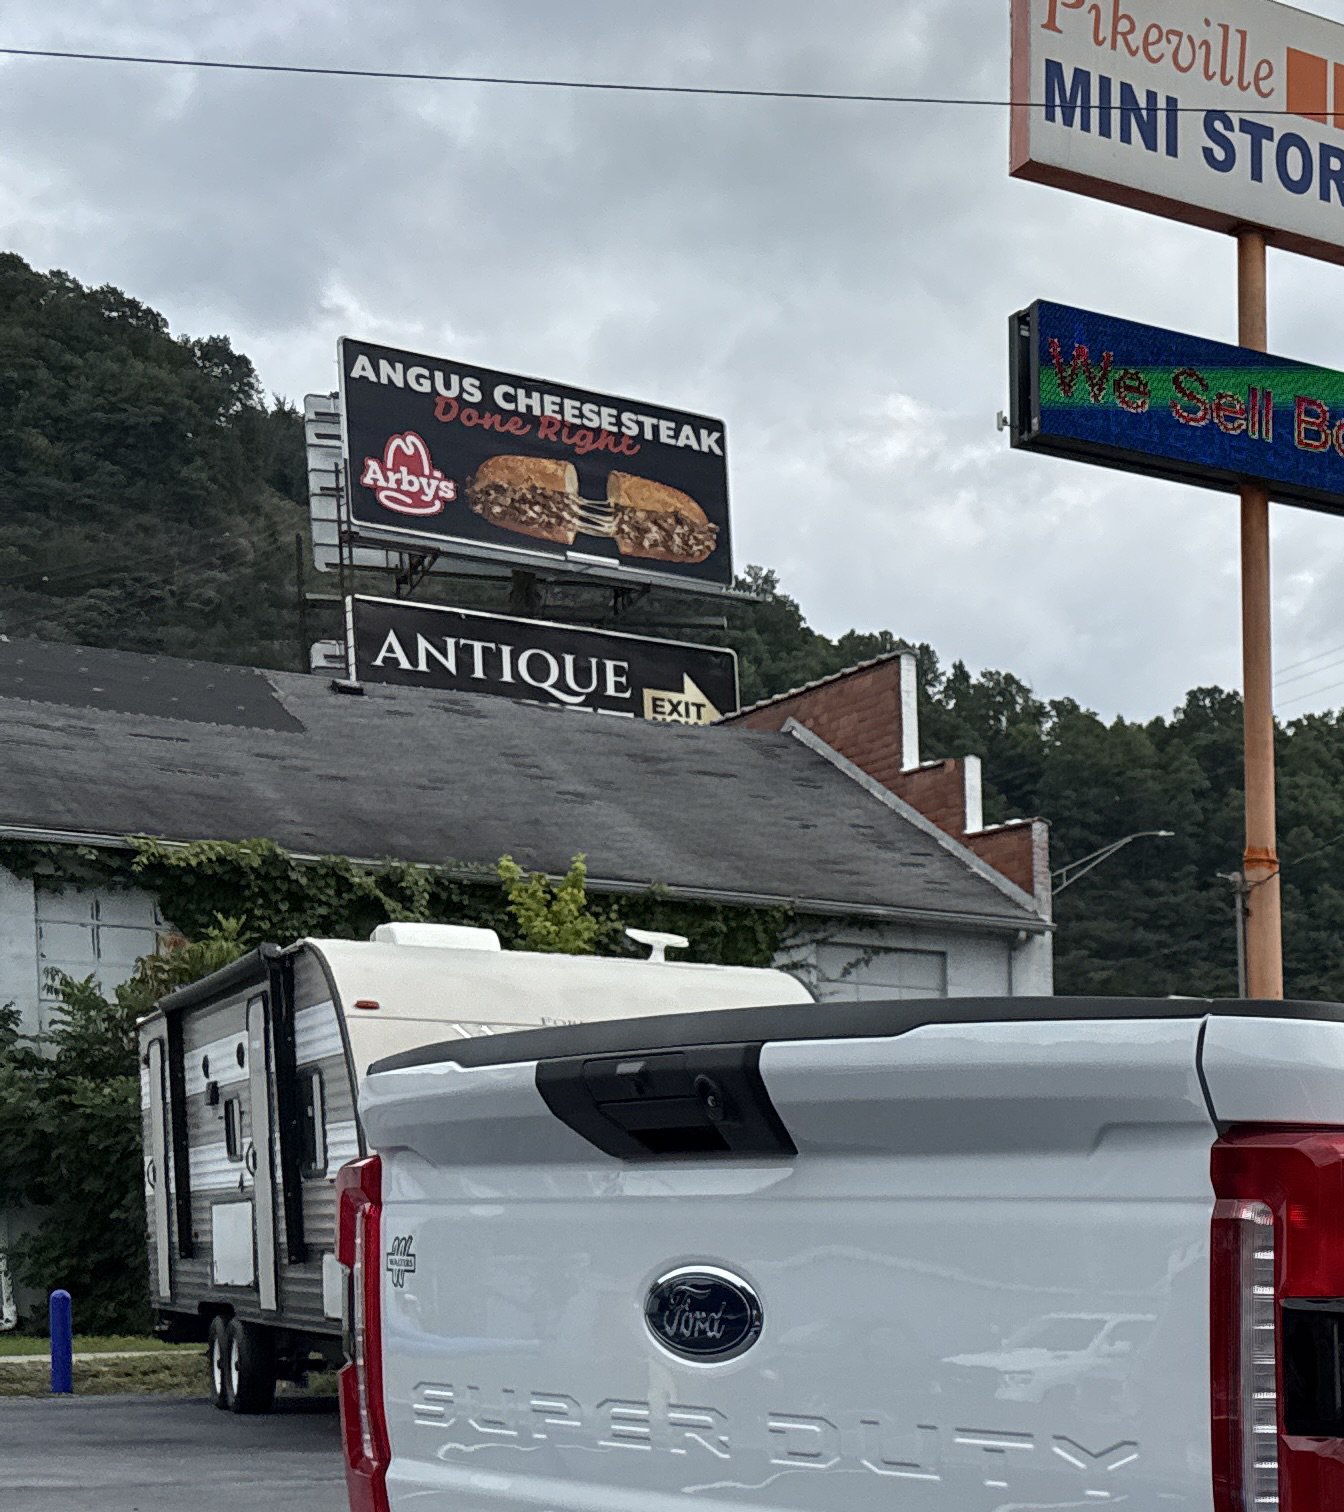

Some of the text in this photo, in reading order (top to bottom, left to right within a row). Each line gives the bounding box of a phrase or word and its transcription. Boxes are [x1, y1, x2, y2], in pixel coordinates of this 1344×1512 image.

[1041, 0, 1274, 98] Pikeville
[1045, 58, 1178, 158] MINI
[350, 354, 724, 457] ANGUS CHEESESTEAK
[433, 395, 642, 456] Done Right
[1047, 338, 1149, 412] We
[1170, 368, 1273, 442] Sell
[363, 460, 454, 501] Arby's
[371, 628, 632, 703] ANTIQUE
[652, 696, 706, 720] EXIT
[662, 1284, 728, 1340] Ford
[413, 1381, 1139, 1497] SUPER DUTY
